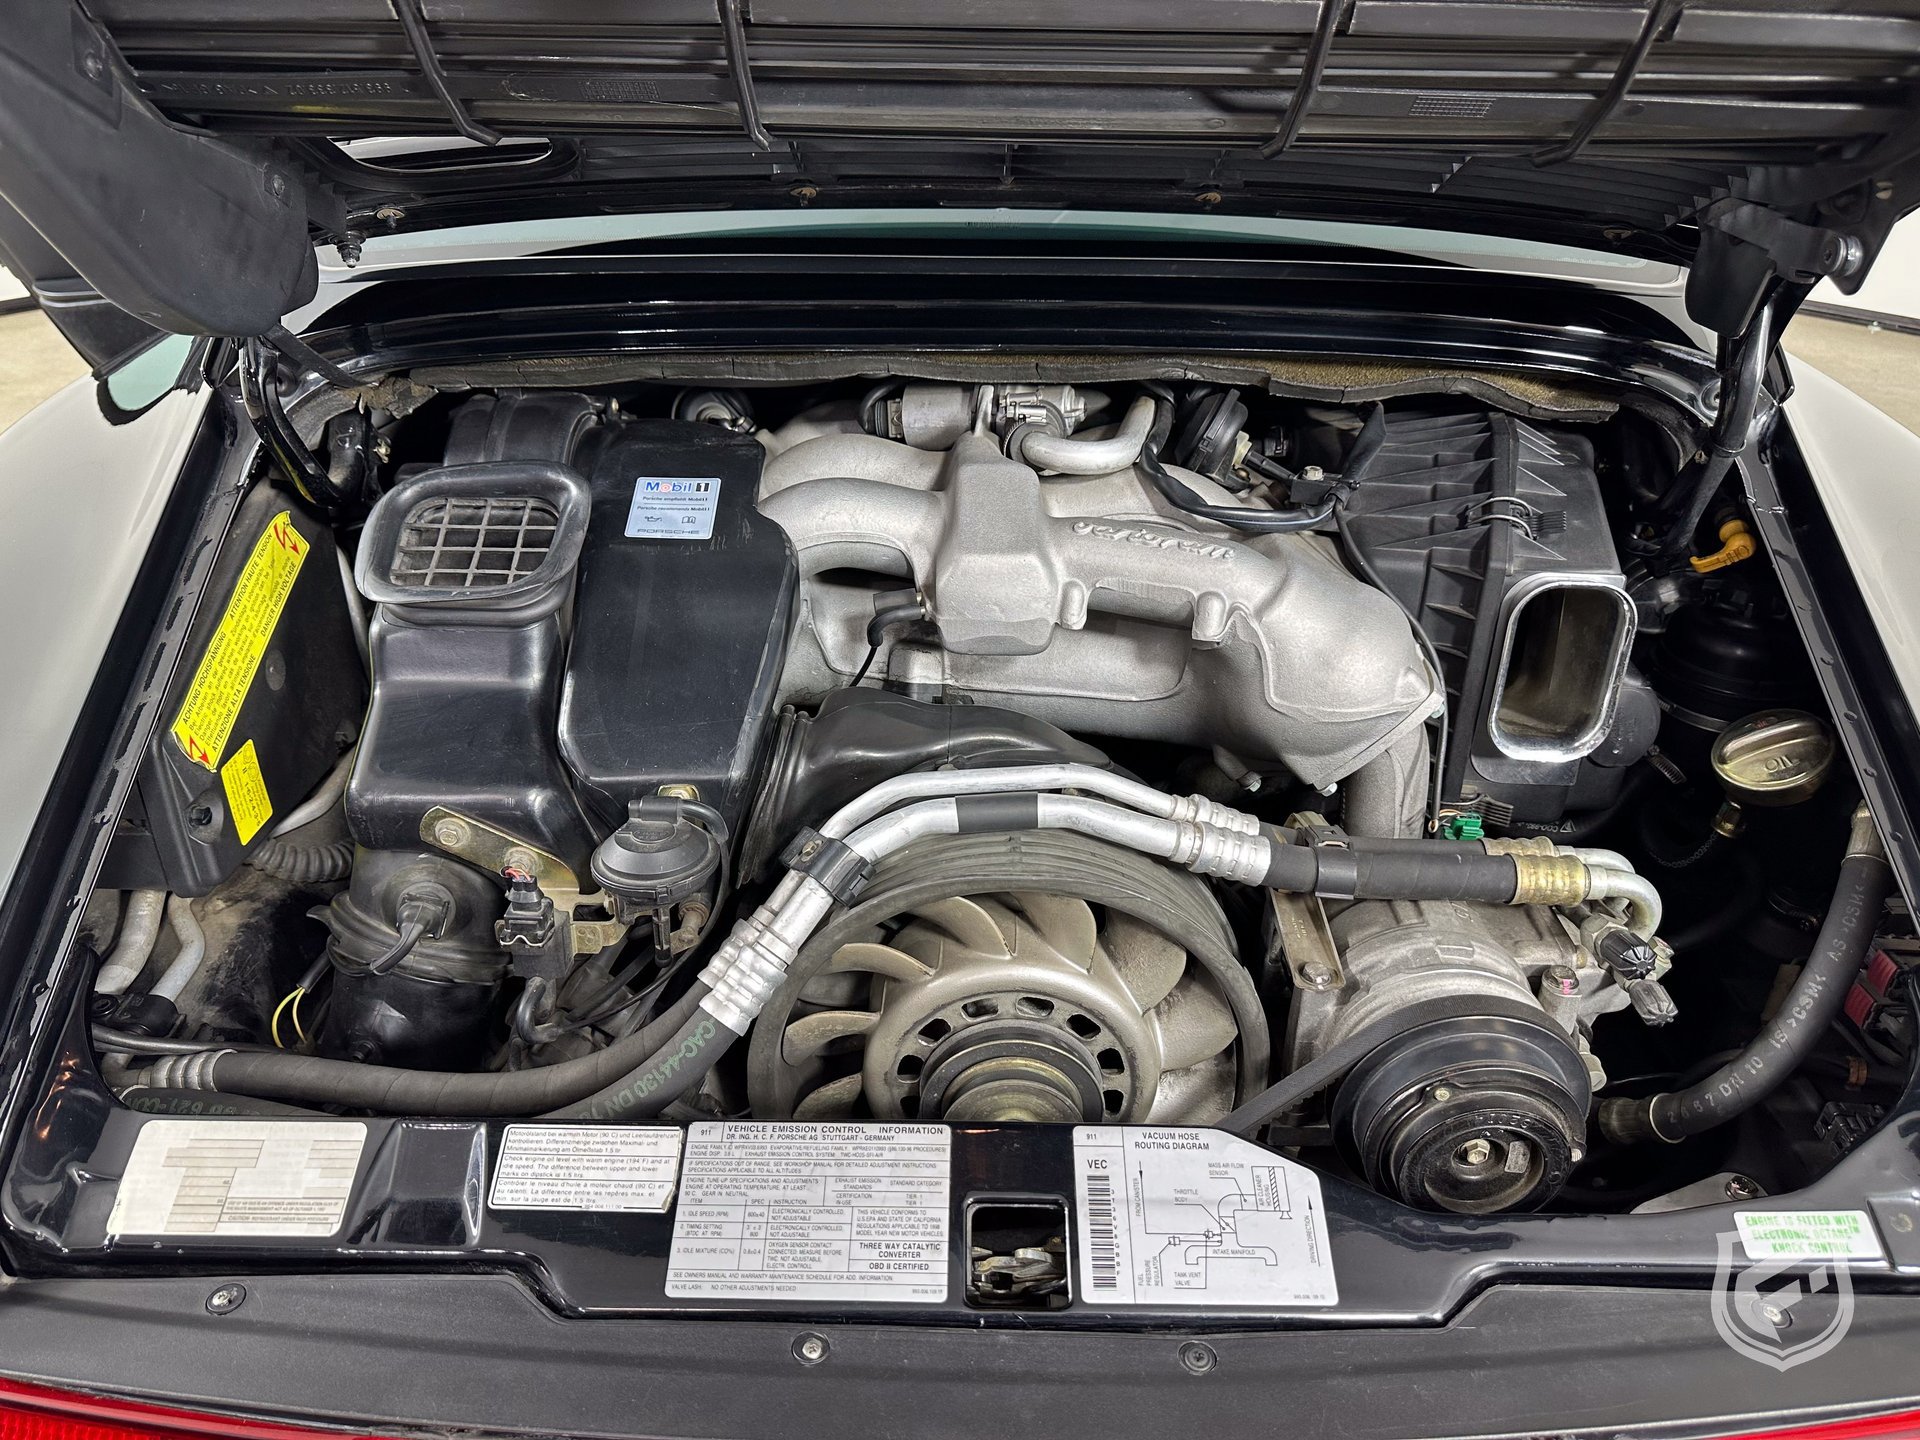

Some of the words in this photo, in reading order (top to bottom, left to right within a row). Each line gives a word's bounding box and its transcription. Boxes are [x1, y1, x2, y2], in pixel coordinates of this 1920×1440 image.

[645, 482, 692, 493] Mobil
[696, 482, 710, 492] 1
[228, 583, 249, 620] ATTENTION
[245, 560, 259, 584] HAUTE
[256, 532, 273, 561] TENSION
[260, 608, 276, 637] DANGER
[272, 591, 283, 609] HIGH
[280, 561, 297, 591] VOLTAGE
[194, 712, 207, 736] Electric
[205, 692, 216, 710] shock
[214, 665, 228, 690] suffered
[225, 648, 235, 664] when
[263, 571, 269, 579] be
[182, 688, 201, 725] ACHTUNG
[197, 631, 226, 689] HOCHSPANNUNG
[194, 691, 209, 718] Arbeiten
[211, 668, 219, 679] der
[211, 707, 233, 752] ATTENZIONE
[230, 688, 241, 707] ALTA
[238, 653, 256, 688] TENSIONE
[199, 717, 213, 742] Danger
[210, 707, 217, 717] de
[1764, 755, 1801, 773] OIL
[1718, 1072, 1745, 1097] DN
[582, 1131, 599, 1139] Motor
[772, 1125, 817, 1133] EMISSION
[821, 1126, 867, 1134] CONTROL
[879, 1126, 943, 1135] INFORMATION
[1142, 1132, 1176, 1140] VACUUM
[1178, 1132, 1200, 1140] HOSE
[1135, 1142, 1170, 1150] ROUTING
[1172, 1142, 1210, 1150] DIAGRAM
[582, 1164, 608, 1172] between
[1087, 1159, 1108, 1169] VEC
[1744, 1215, 1779, 1227] ENGINE
[1797, 1215, 1830, 1226] FITTED
[1832, 1215, 1858, 1225] WITH
[860, 1242, 882, 1250] THREE
[893, 1263, 929, 1271] CERTIFIED
